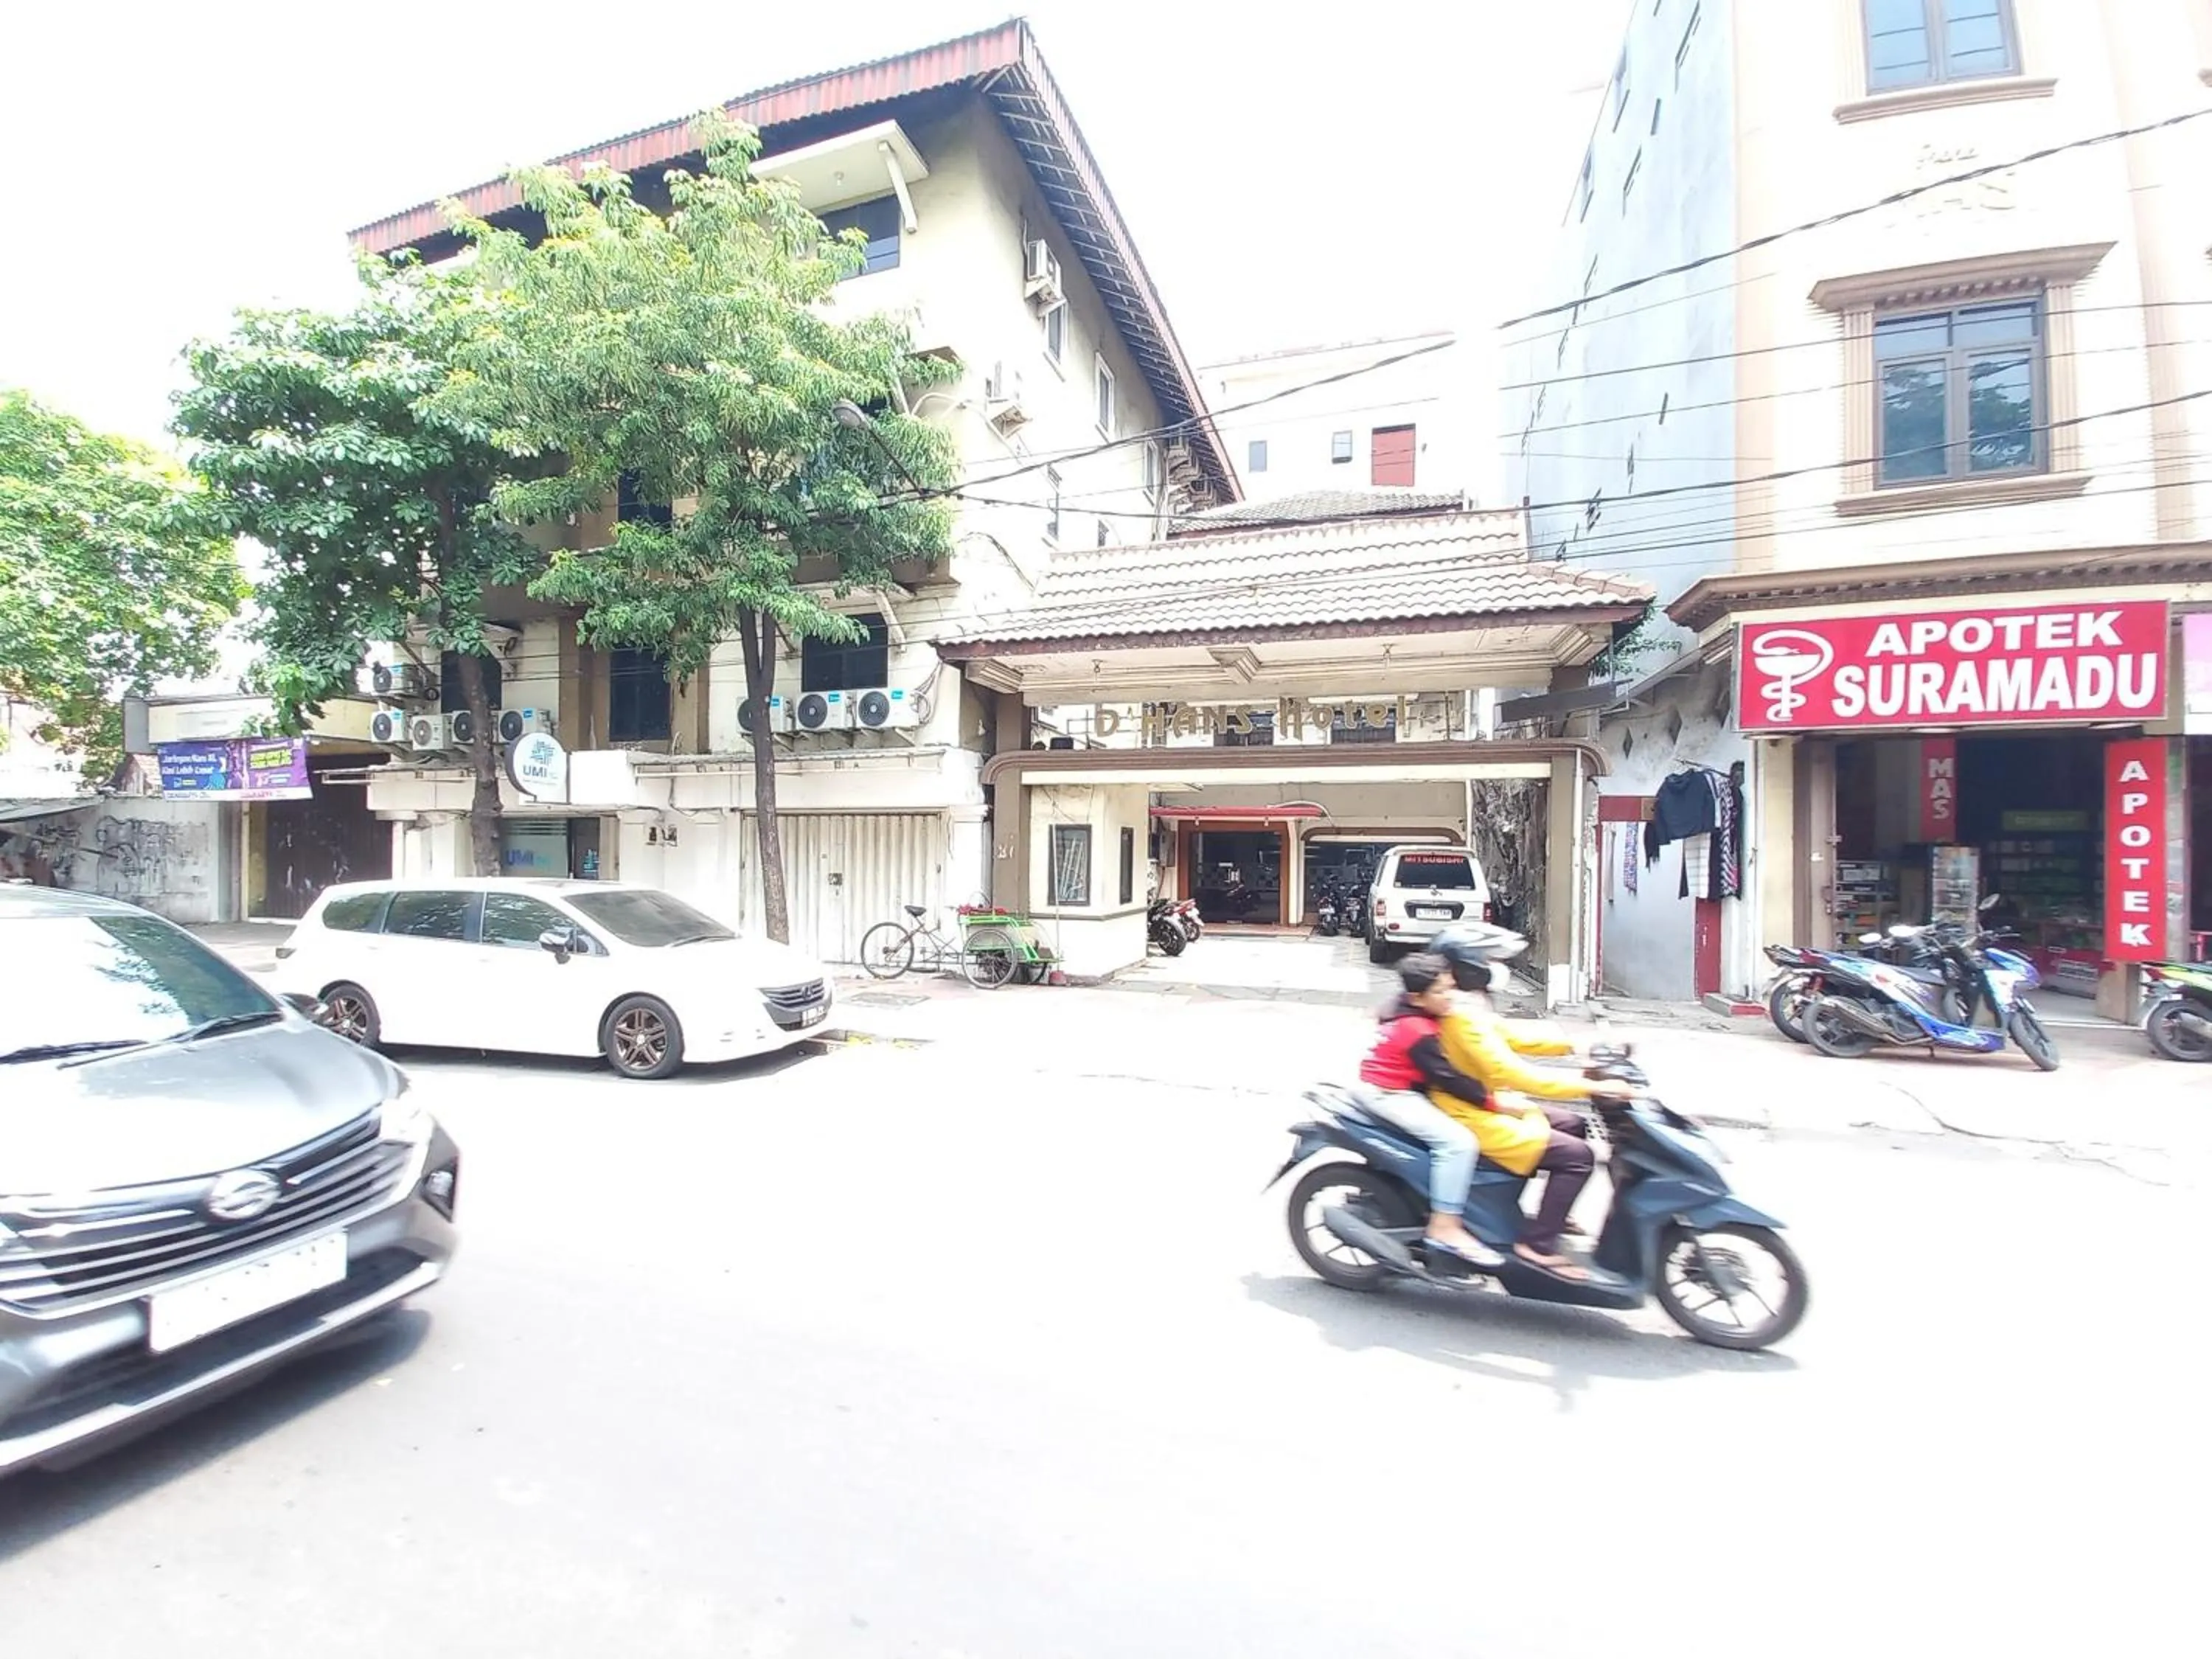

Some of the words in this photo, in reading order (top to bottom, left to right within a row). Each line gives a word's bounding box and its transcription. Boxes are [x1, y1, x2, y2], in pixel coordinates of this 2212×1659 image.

[1865, 611, 2124, 657] APOTEK
[1832, 653, 2158, 717] SURAMADU
[523, 765, 548, 778] UMI
[2118, 759, 2154, 947] APOTEK
